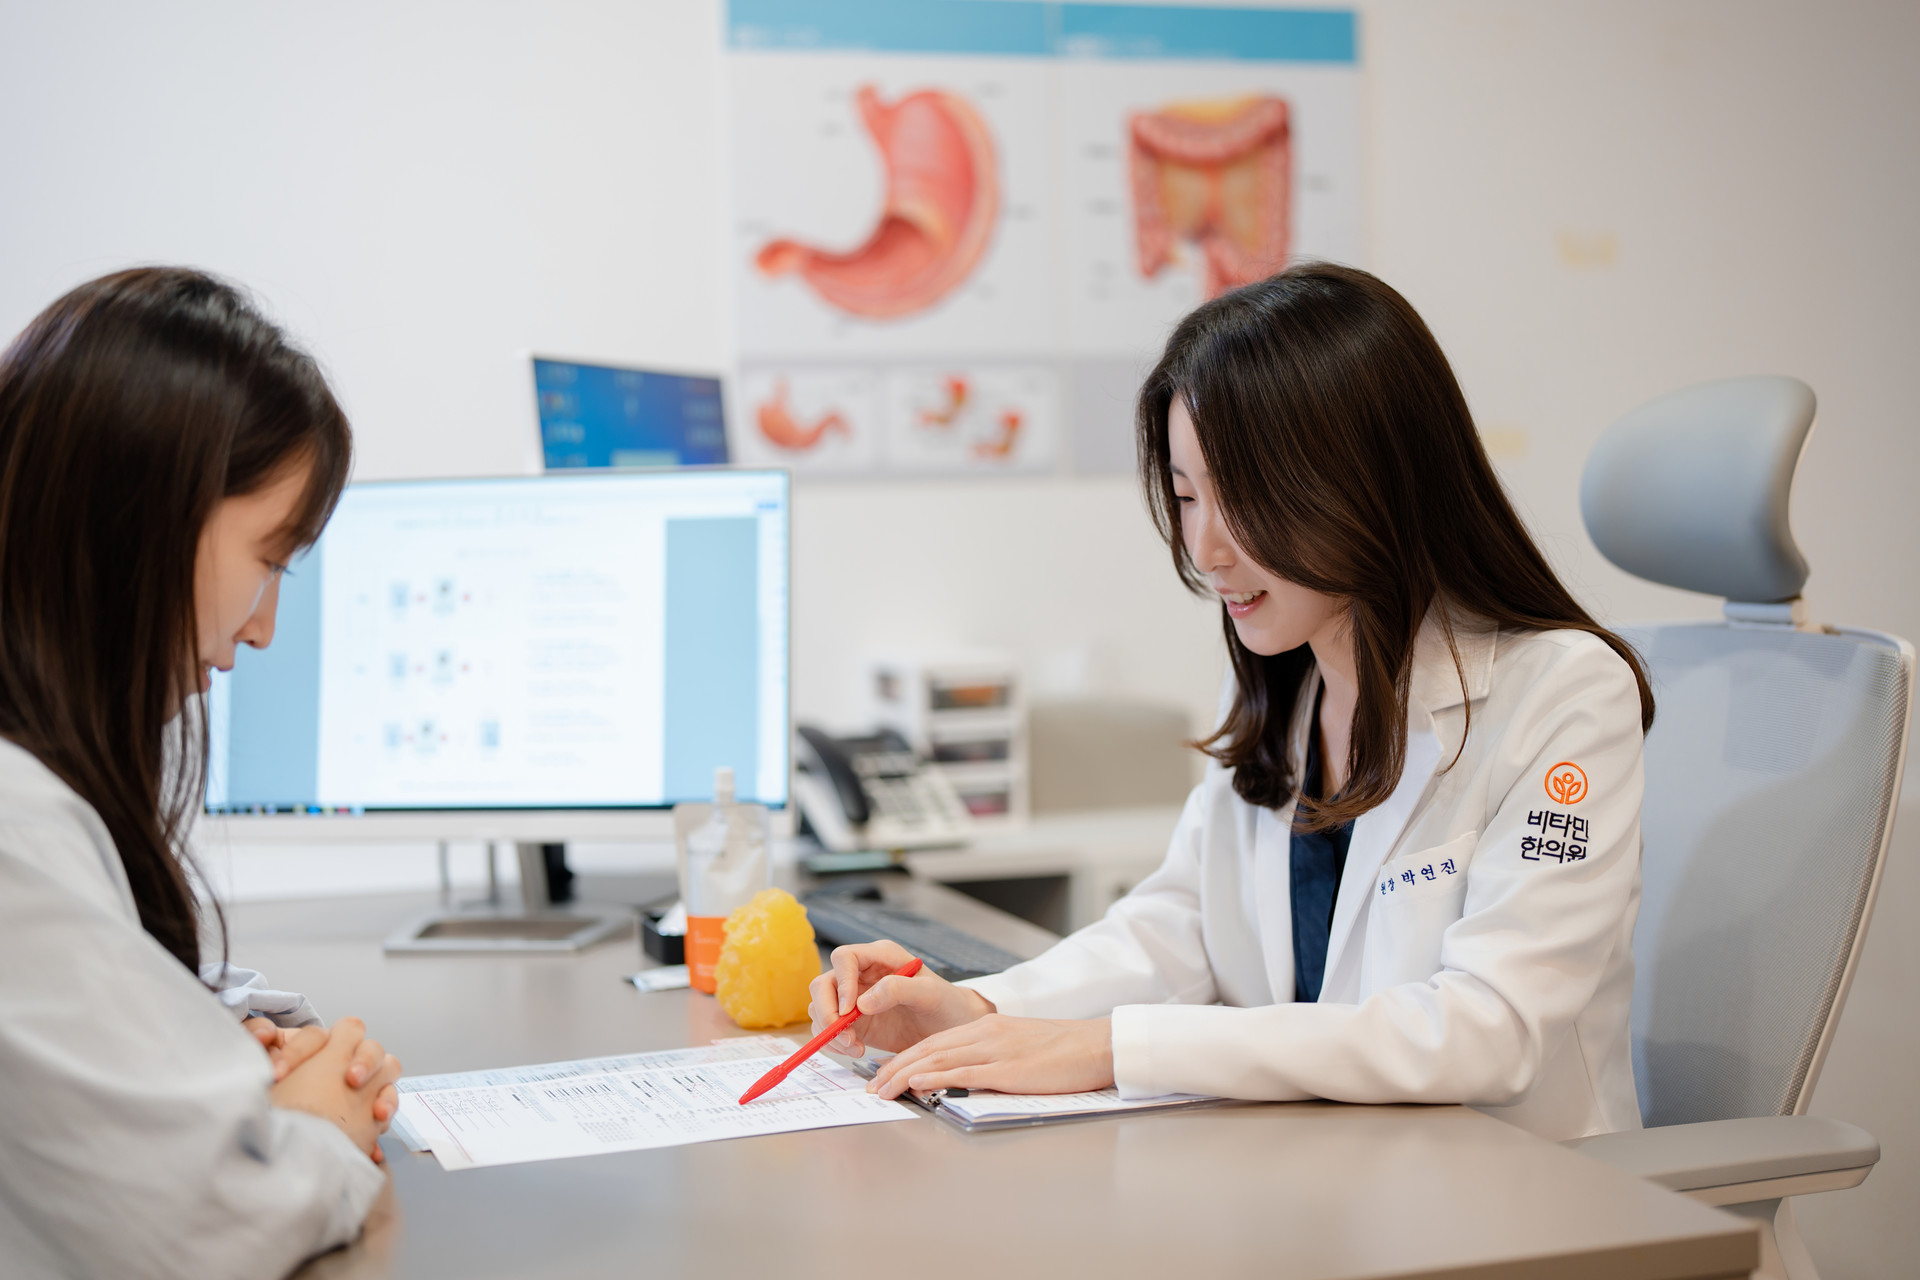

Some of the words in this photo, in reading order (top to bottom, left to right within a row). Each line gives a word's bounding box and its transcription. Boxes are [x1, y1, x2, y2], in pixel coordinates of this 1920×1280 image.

[1527, 810, 1589, 843] 비타민
[1521, 836, 1587, 864] 한의원
[1401, 859, 1457, 886] 박연진
